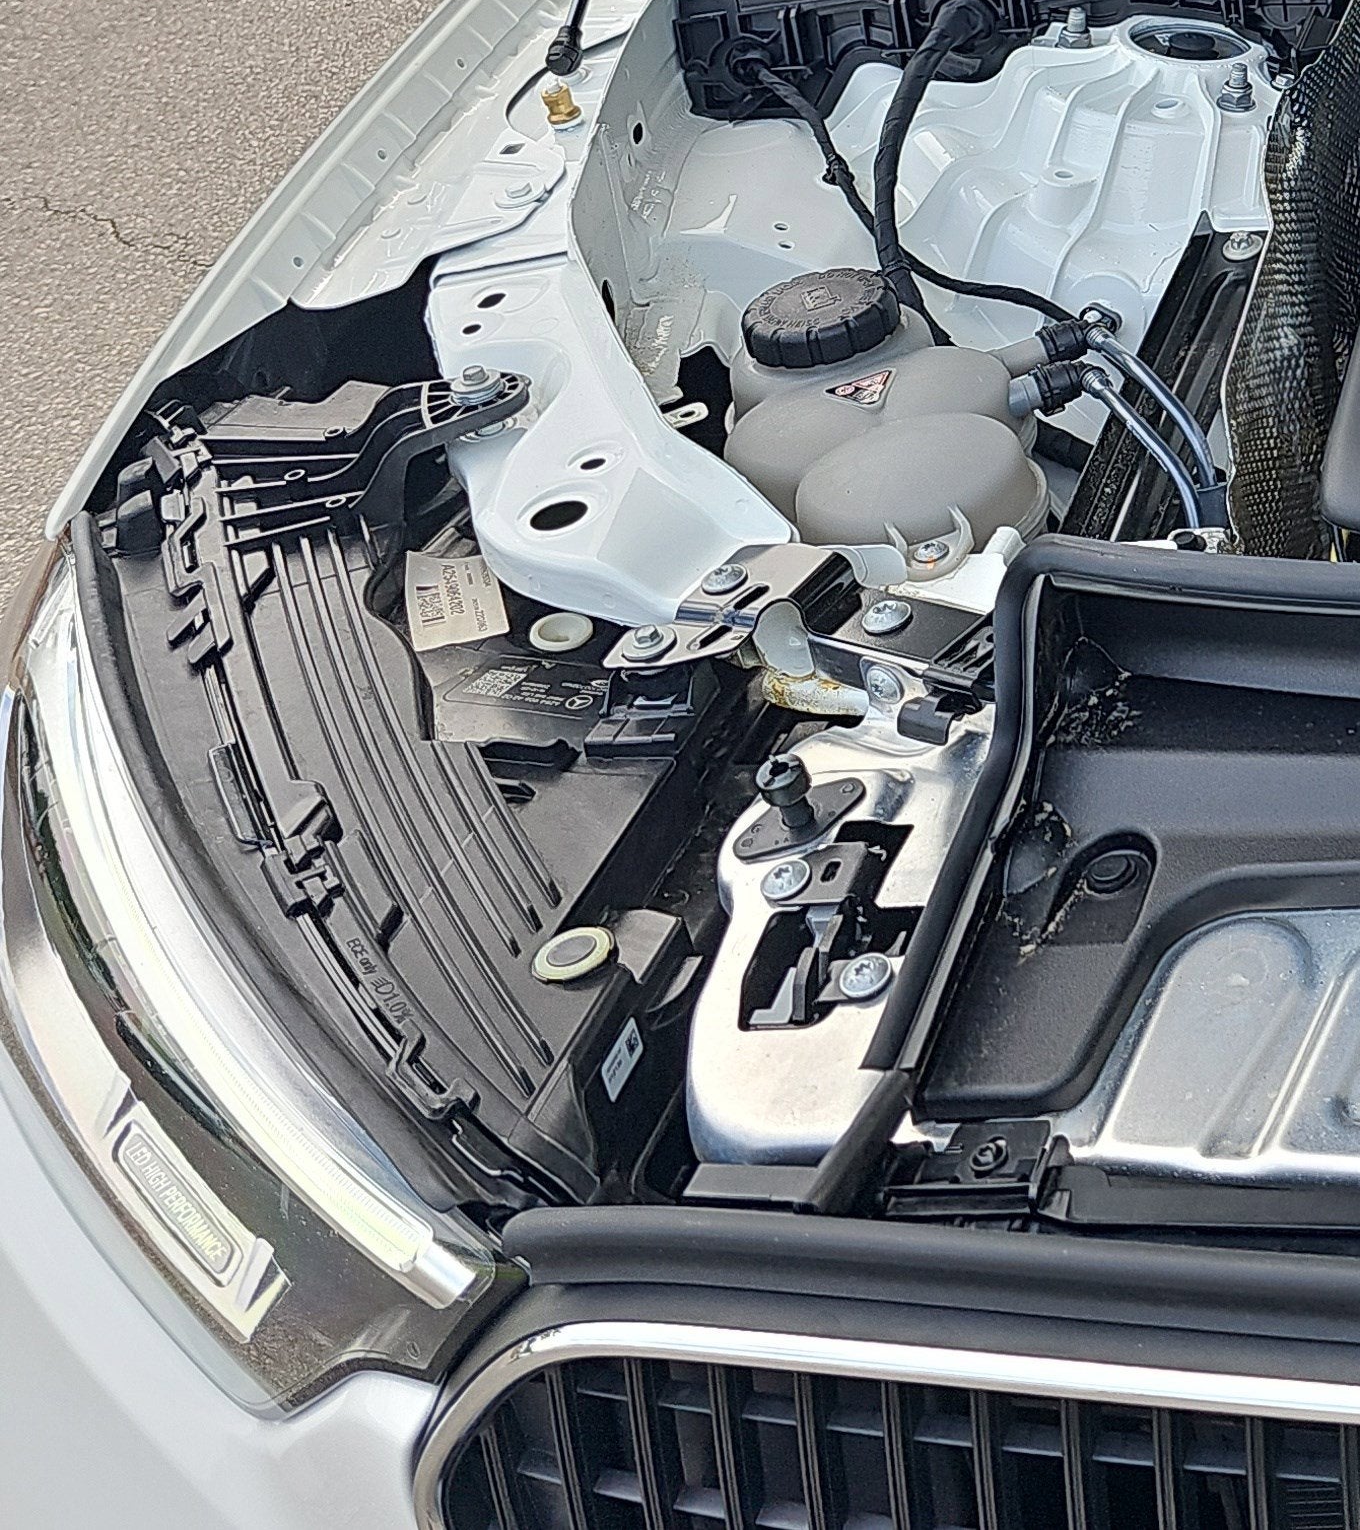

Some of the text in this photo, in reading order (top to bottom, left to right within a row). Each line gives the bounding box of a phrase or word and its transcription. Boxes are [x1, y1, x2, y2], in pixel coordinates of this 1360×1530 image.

[345, 934, 369, 960] ECE
[355, 954, 380, 979] only
[125, 1140, 227, 1264] LED HIGH PERFORMANCE
